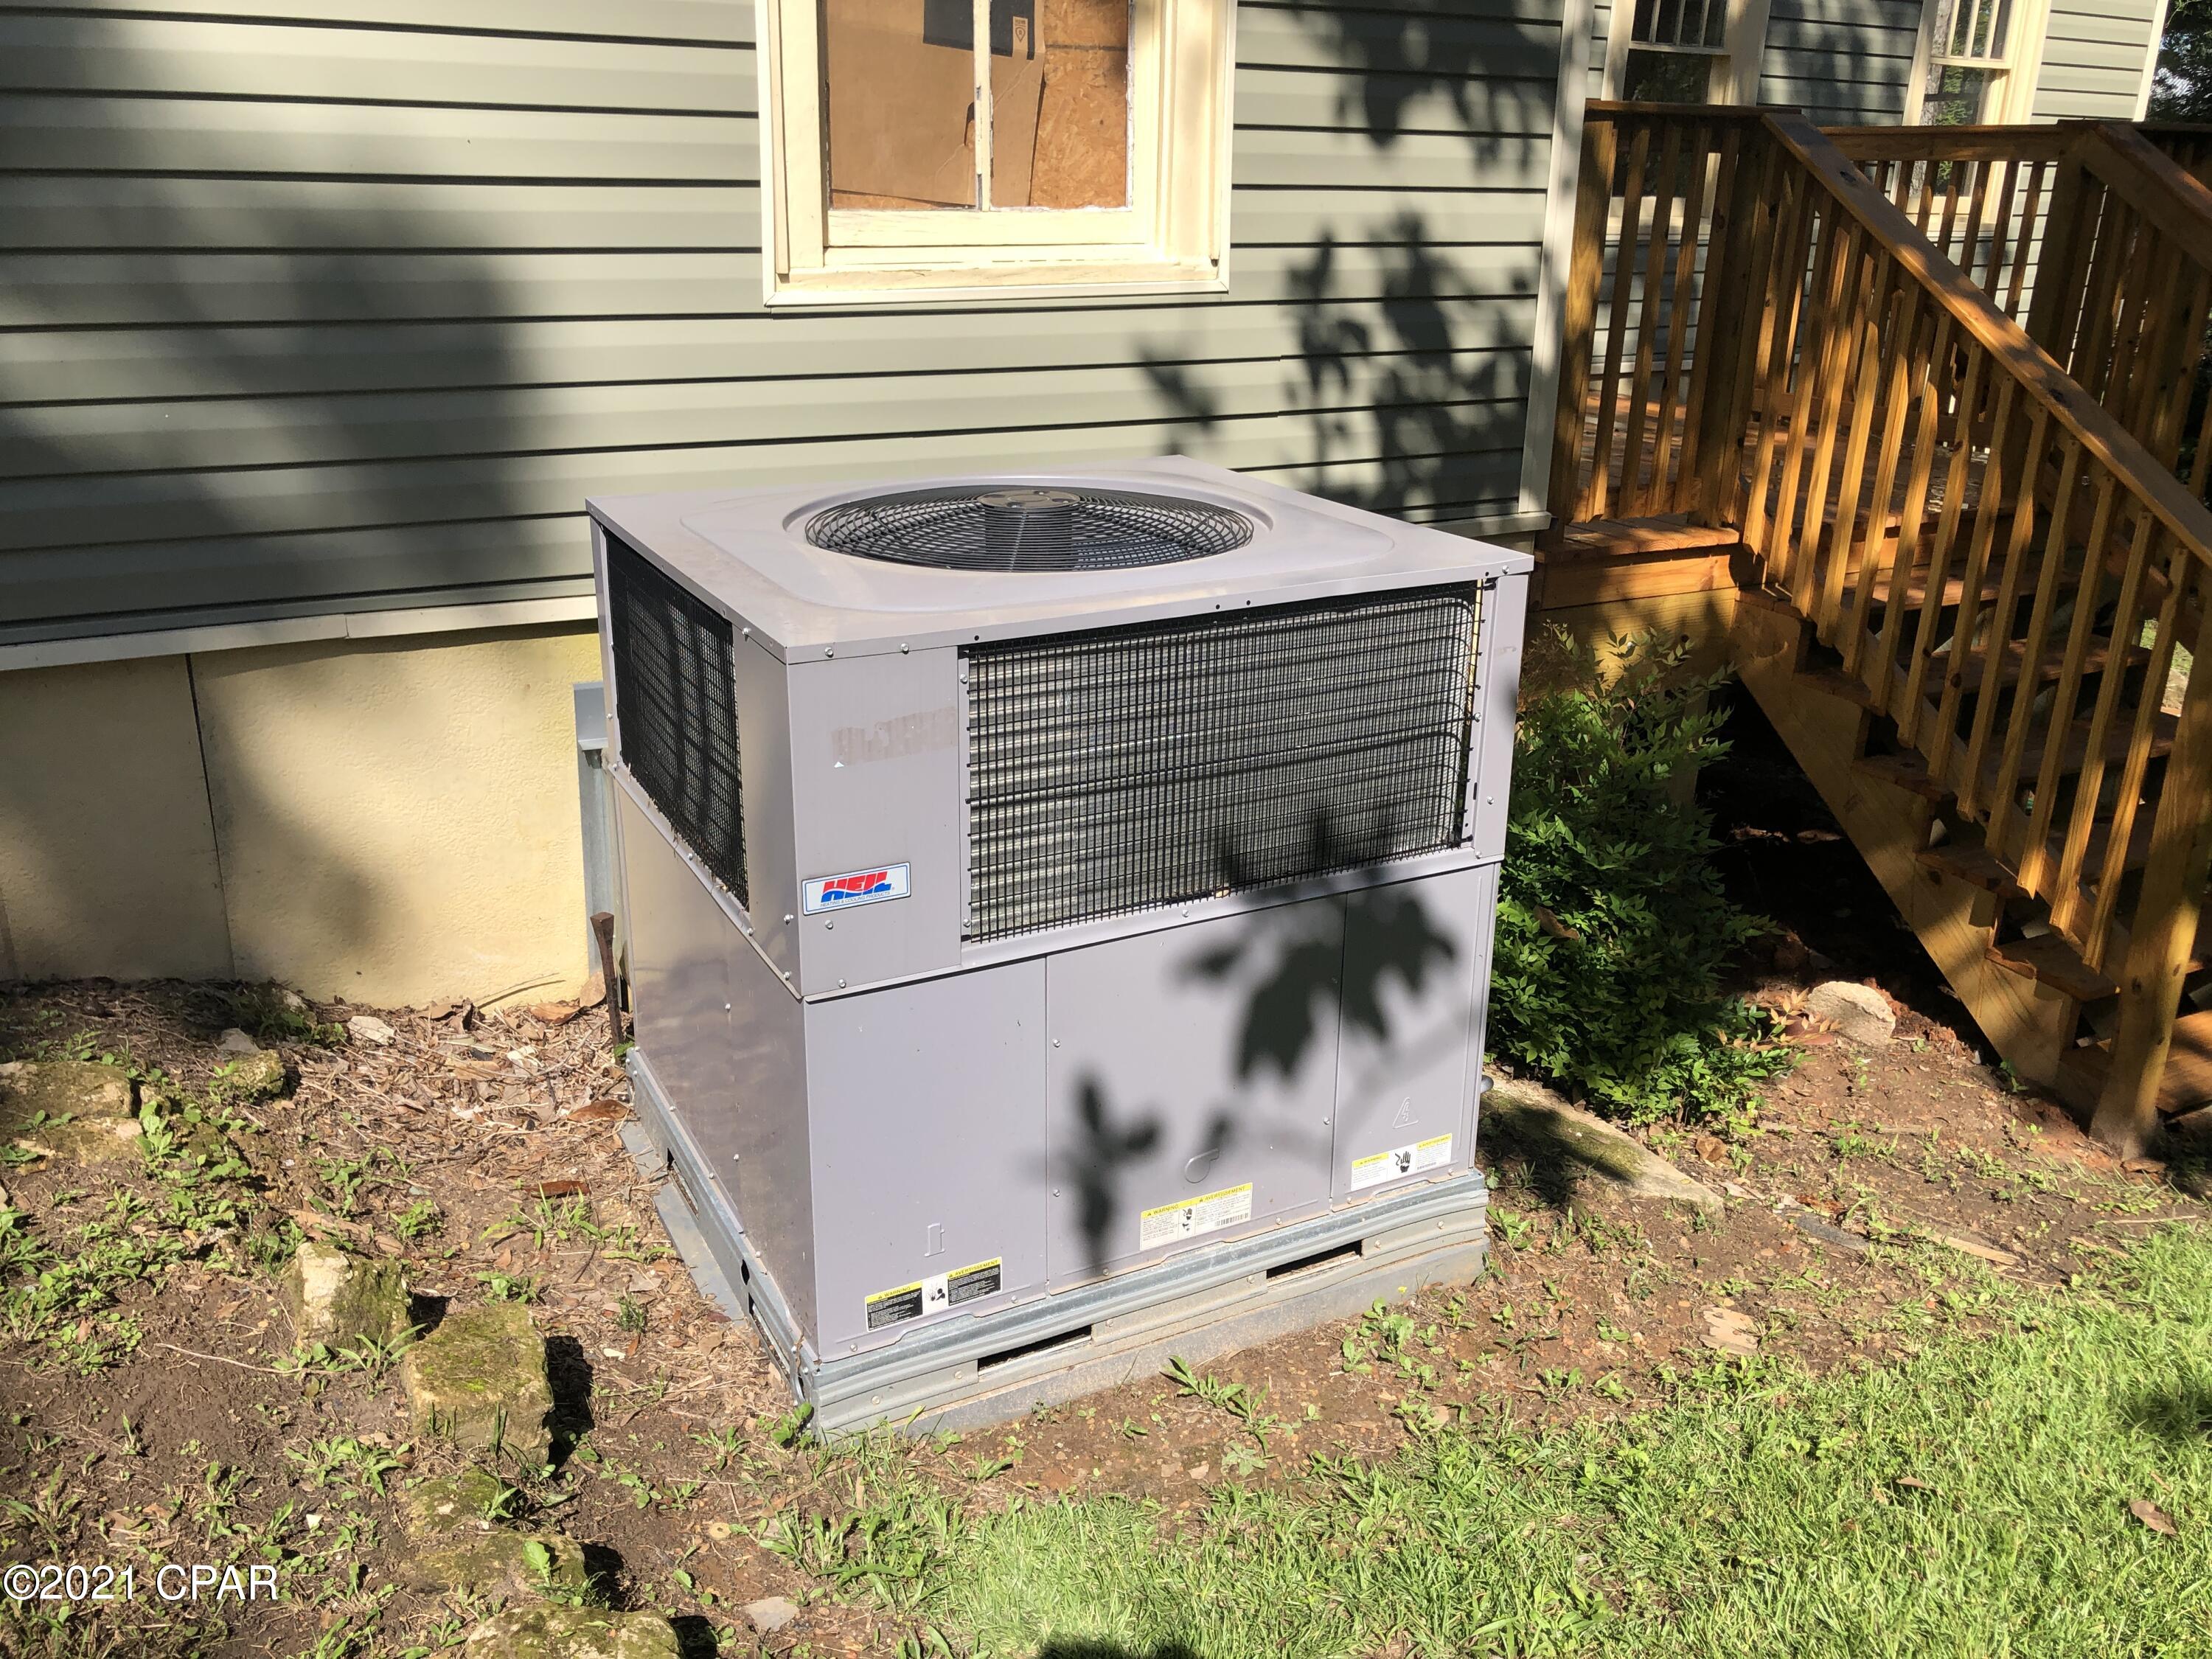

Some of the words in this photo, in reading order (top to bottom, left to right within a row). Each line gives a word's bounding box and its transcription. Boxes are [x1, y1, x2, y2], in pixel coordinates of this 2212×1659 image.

[821, 871, 892, 903] HEIL
[820, 899, 841, 908] HEATING
[844, 894, 866, 903] COOLING
[866, 891, 891, 900] PRODUCTS
[1153, 1203, 1179, 1215] WARNING
[884, 1286, 911, 1298] WARNING
